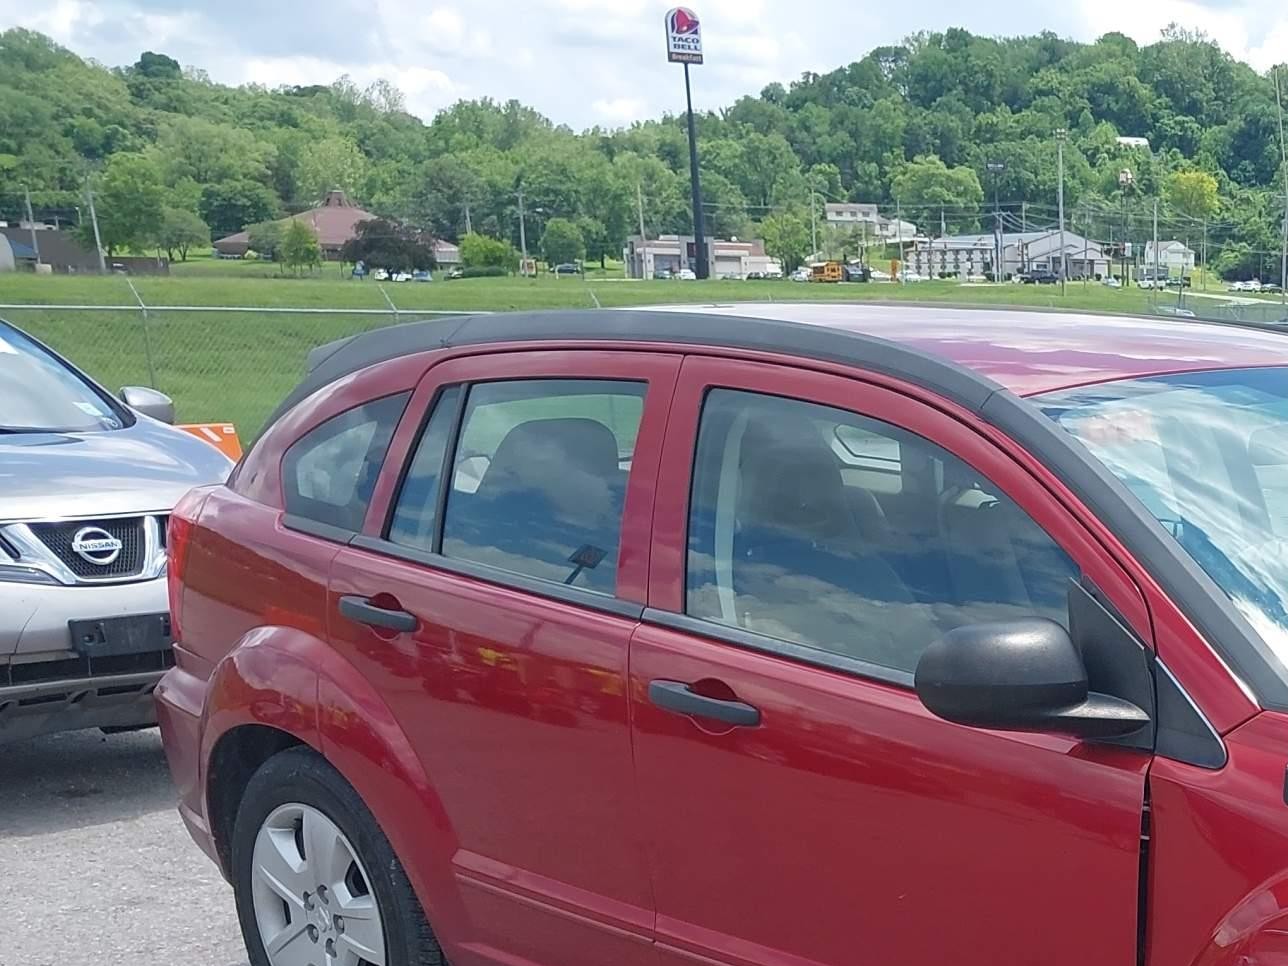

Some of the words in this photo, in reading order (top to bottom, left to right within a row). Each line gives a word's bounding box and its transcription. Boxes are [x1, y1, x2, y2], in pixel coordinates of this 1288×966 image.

[672, 36, 699, 44] TACO
[673, 43, 701, 51] BELL
[79, 541, 118, 550] NISSAN
